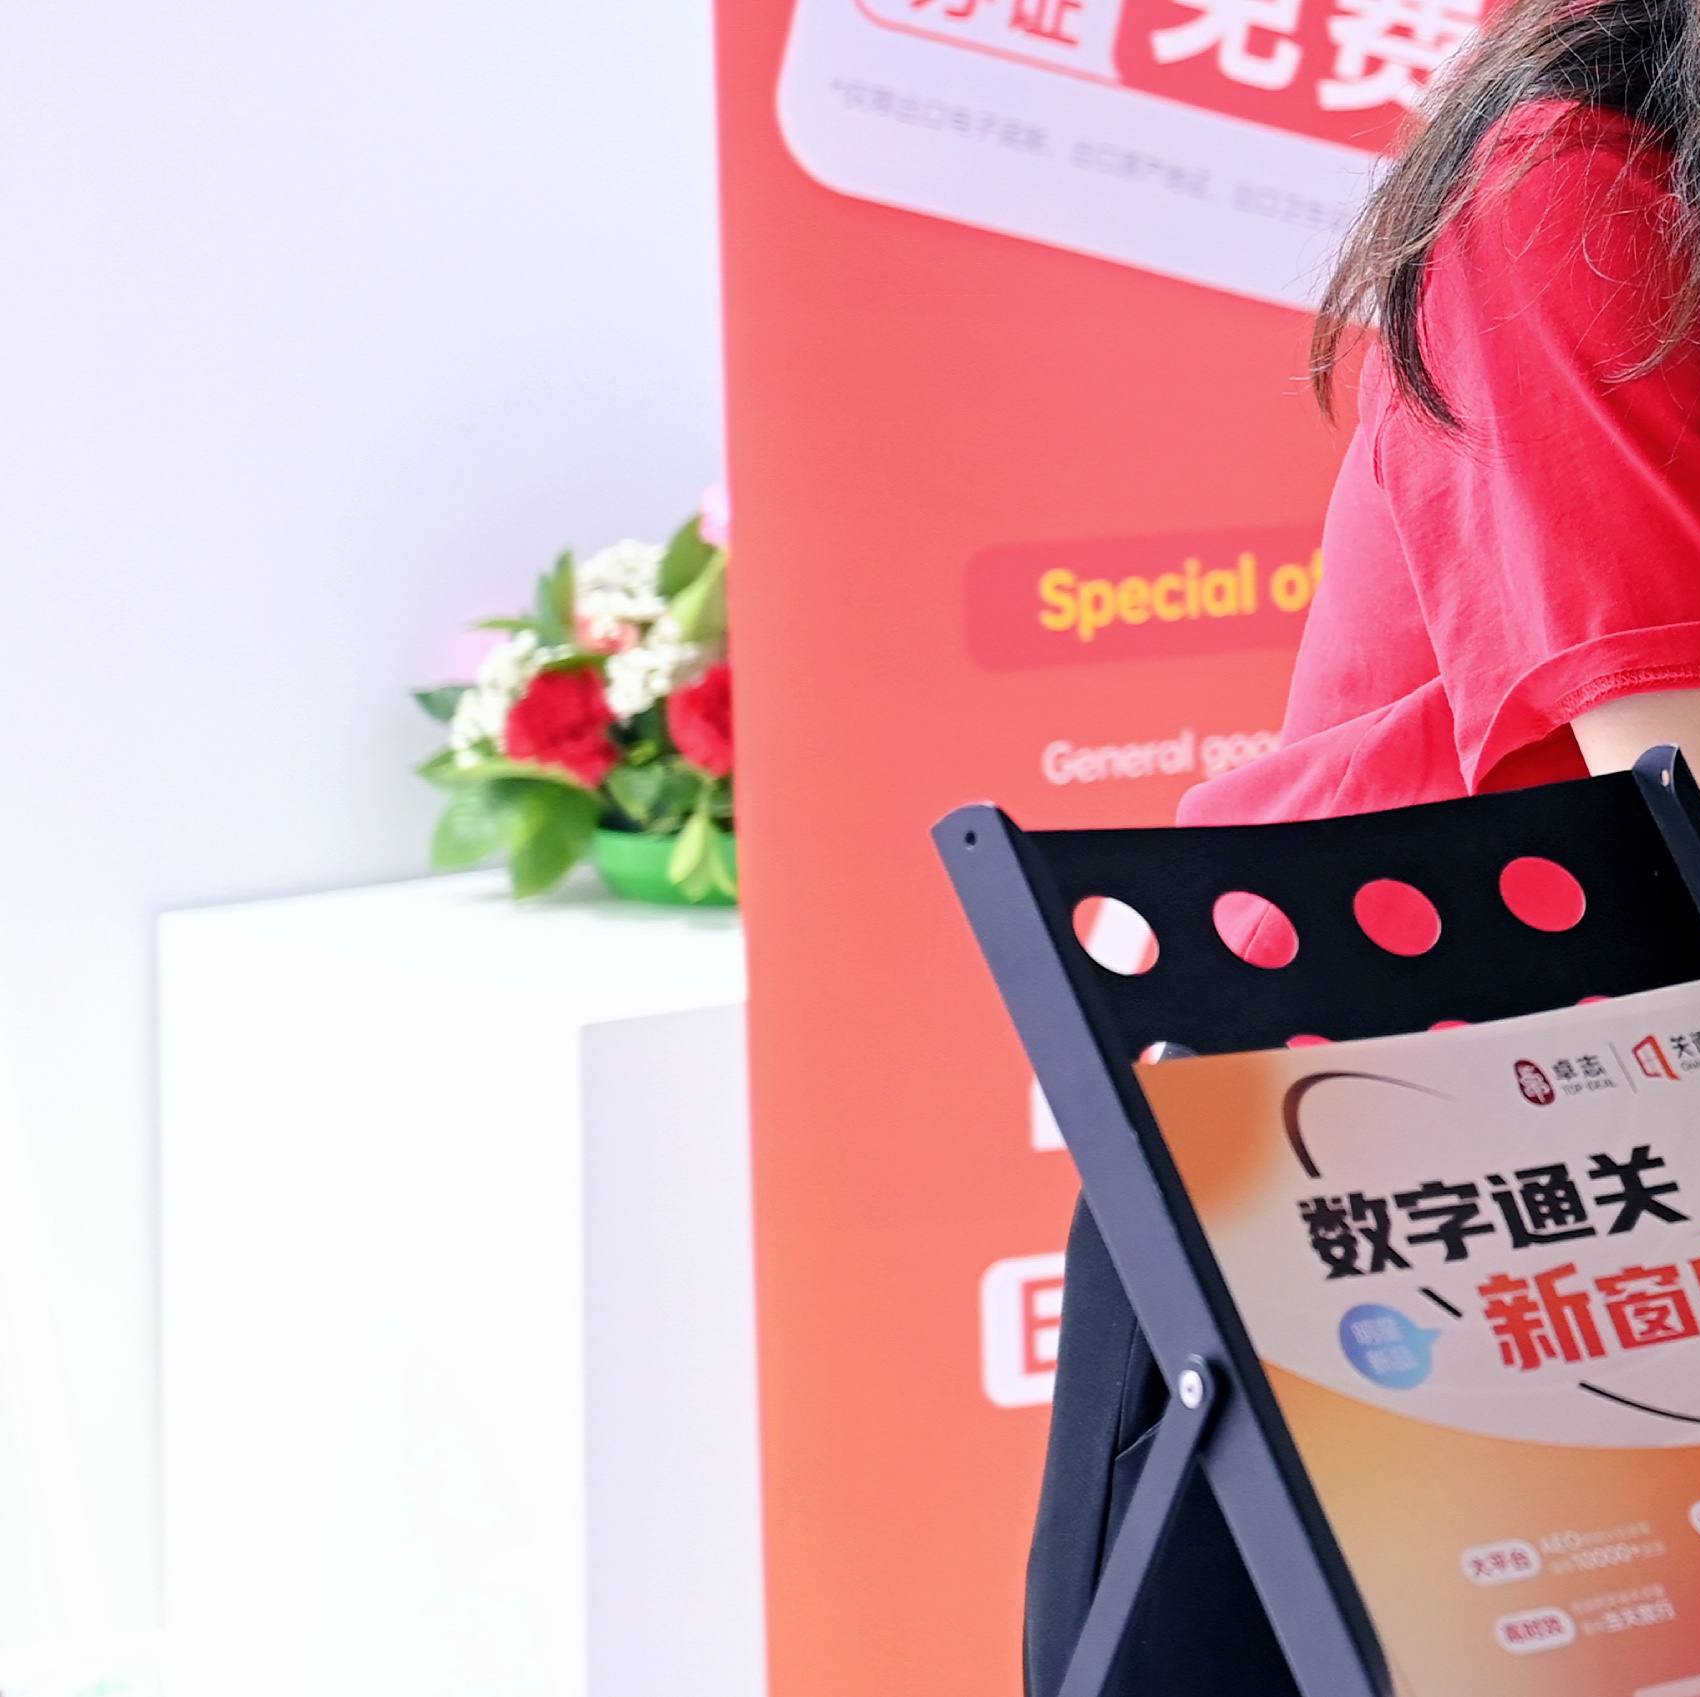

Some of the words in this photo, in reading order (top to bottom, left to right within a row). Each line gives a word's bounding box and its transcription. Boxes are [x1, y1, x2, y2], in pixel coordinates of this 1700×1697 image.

[1039, 551, 1257, 643] Special
[1042, 727, 1197, 786] General
[1552, 1054, 1607, 1082] 卓志
[1297, 1143, 1692, 1282] 数字通关
